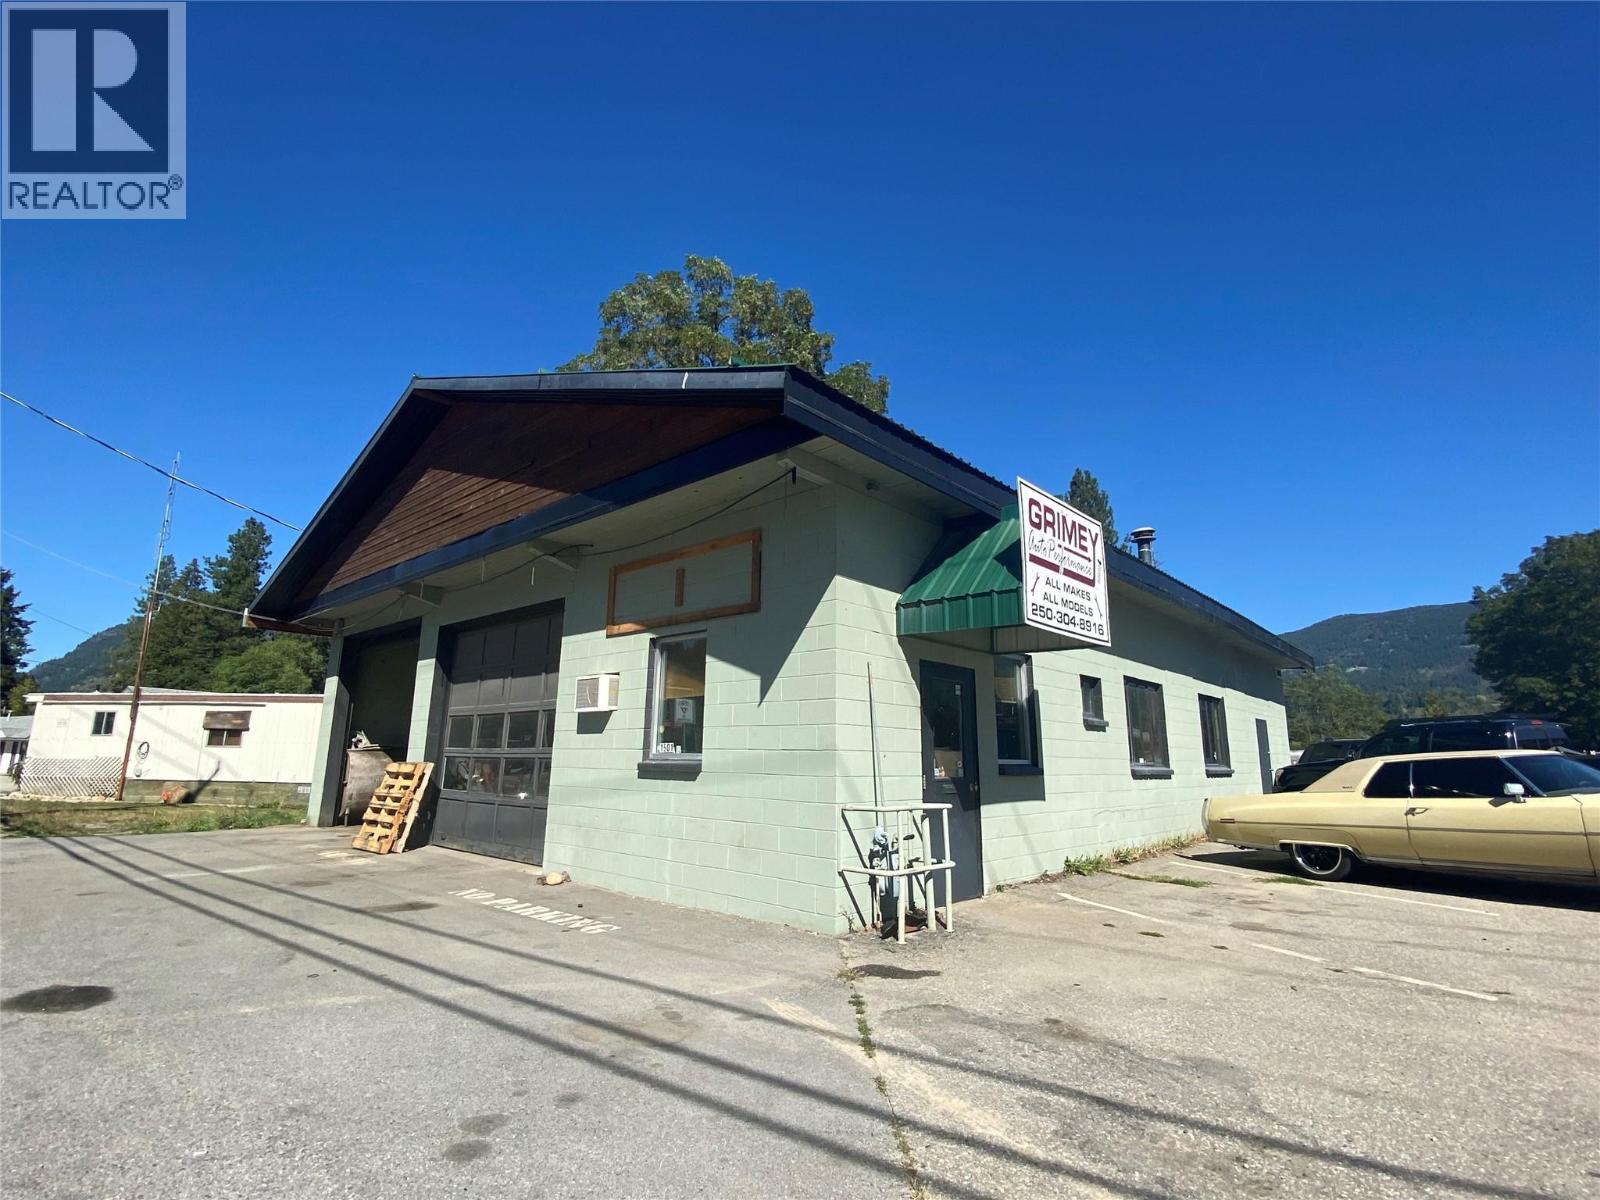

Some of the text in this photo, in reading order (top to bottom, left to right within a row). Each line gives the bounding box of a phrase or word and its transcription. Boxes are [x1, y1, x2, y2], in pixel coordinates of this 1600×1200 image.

[1028, 497, 1099, 553] GRIMEY
[1043, 591, 1094, 617] ALL MODELS
[1045, 577, 1091, 602] ALL MAKES
[480, 897, 622, 933] PARKING
